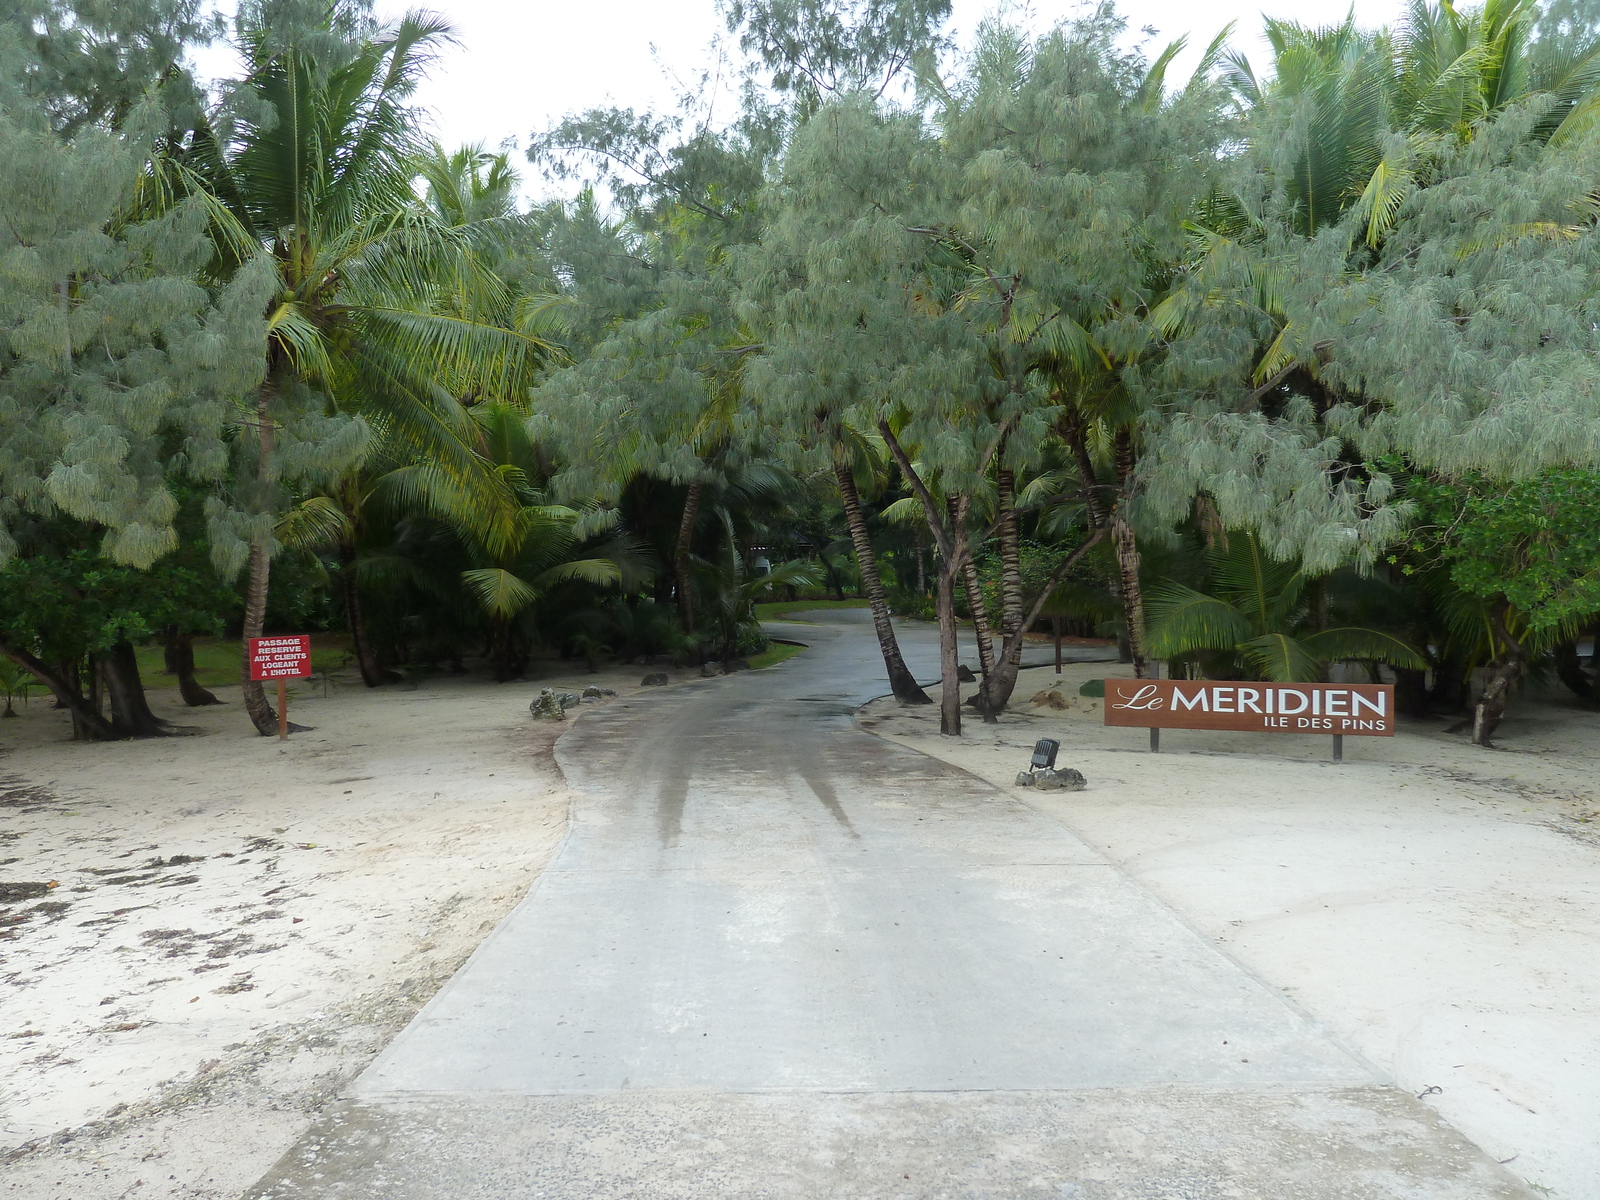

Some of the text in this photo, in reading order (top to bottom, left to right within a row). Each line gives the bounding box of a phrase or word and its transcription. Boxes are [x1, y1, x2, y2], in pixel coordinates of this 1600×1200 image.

[258, 638, 301, 647] PASSAGE
[258, 646, 302, 654] RESERVE
[274, 653, 307, 661] CLIENTS
[262, 661, 299, 669] LOGEANT
[270, 668, 301, 676] L'HOTEL
[1111, 684, 1386, 718] Le MERIDIEN
[1264, 716, 1386, 731] ILE DES PINS
